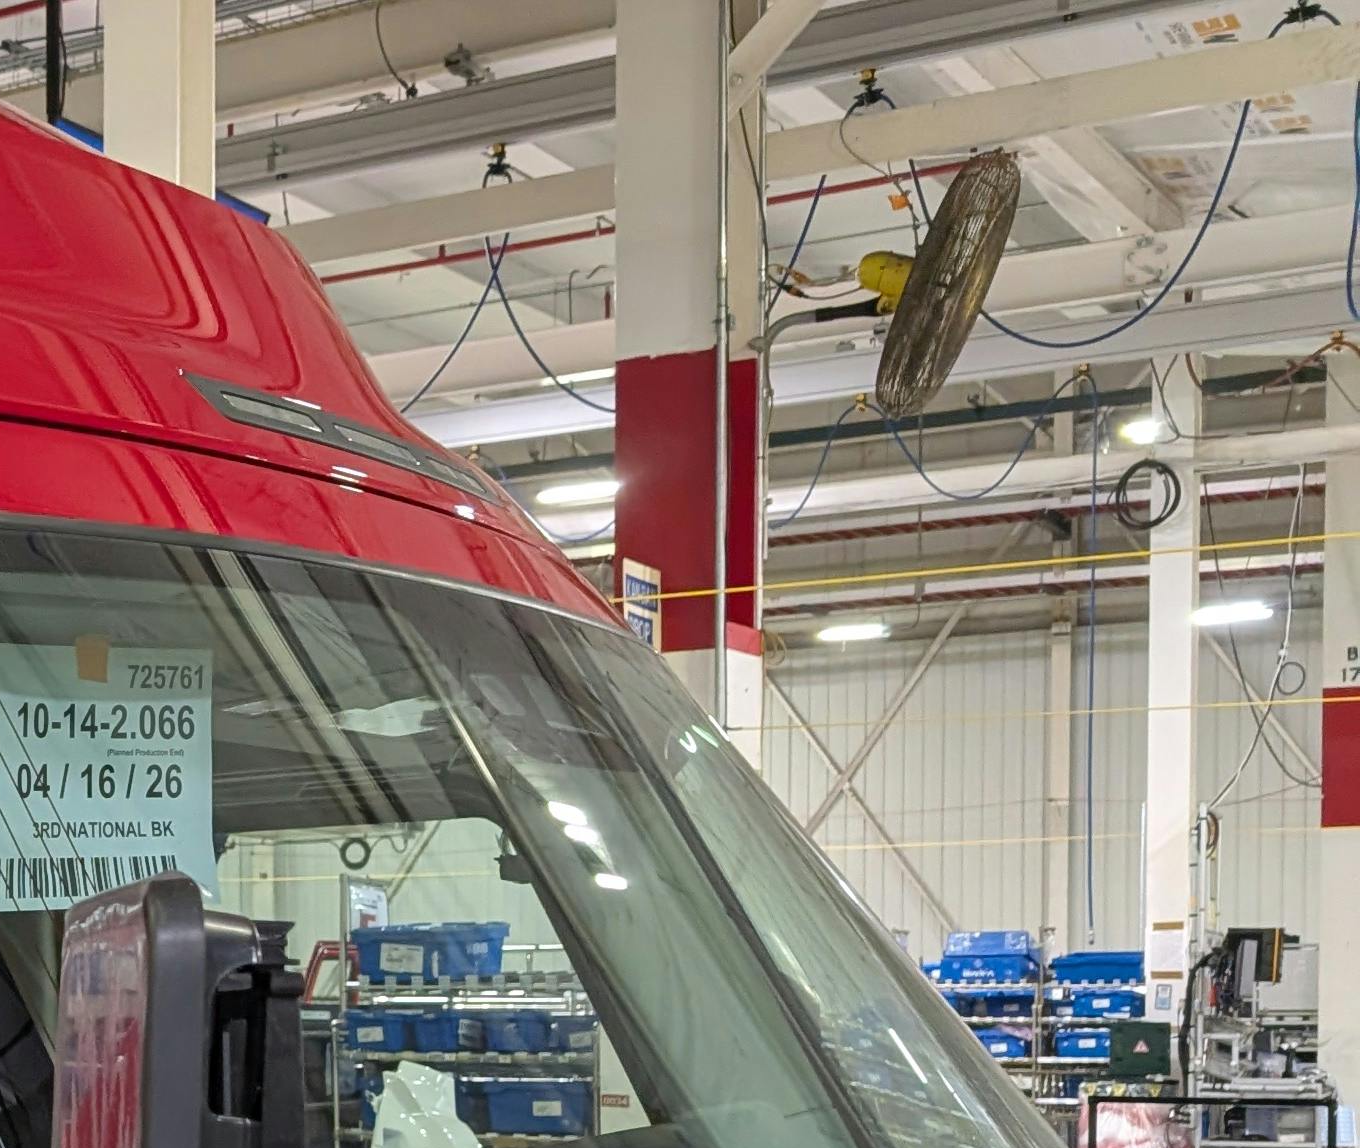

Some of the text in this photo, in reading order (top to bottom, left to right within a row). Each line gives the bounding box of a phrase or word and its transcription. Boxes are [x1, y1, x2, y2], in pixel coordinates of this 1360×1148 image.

[127, 664, 204, 690] 725761
[17, 701, 196, 741] 10-14-2.066
[17, 762, 183, 799] 04 / 16 / 26
[32, 820, 175, 839] 3RD NATIONAL BK
